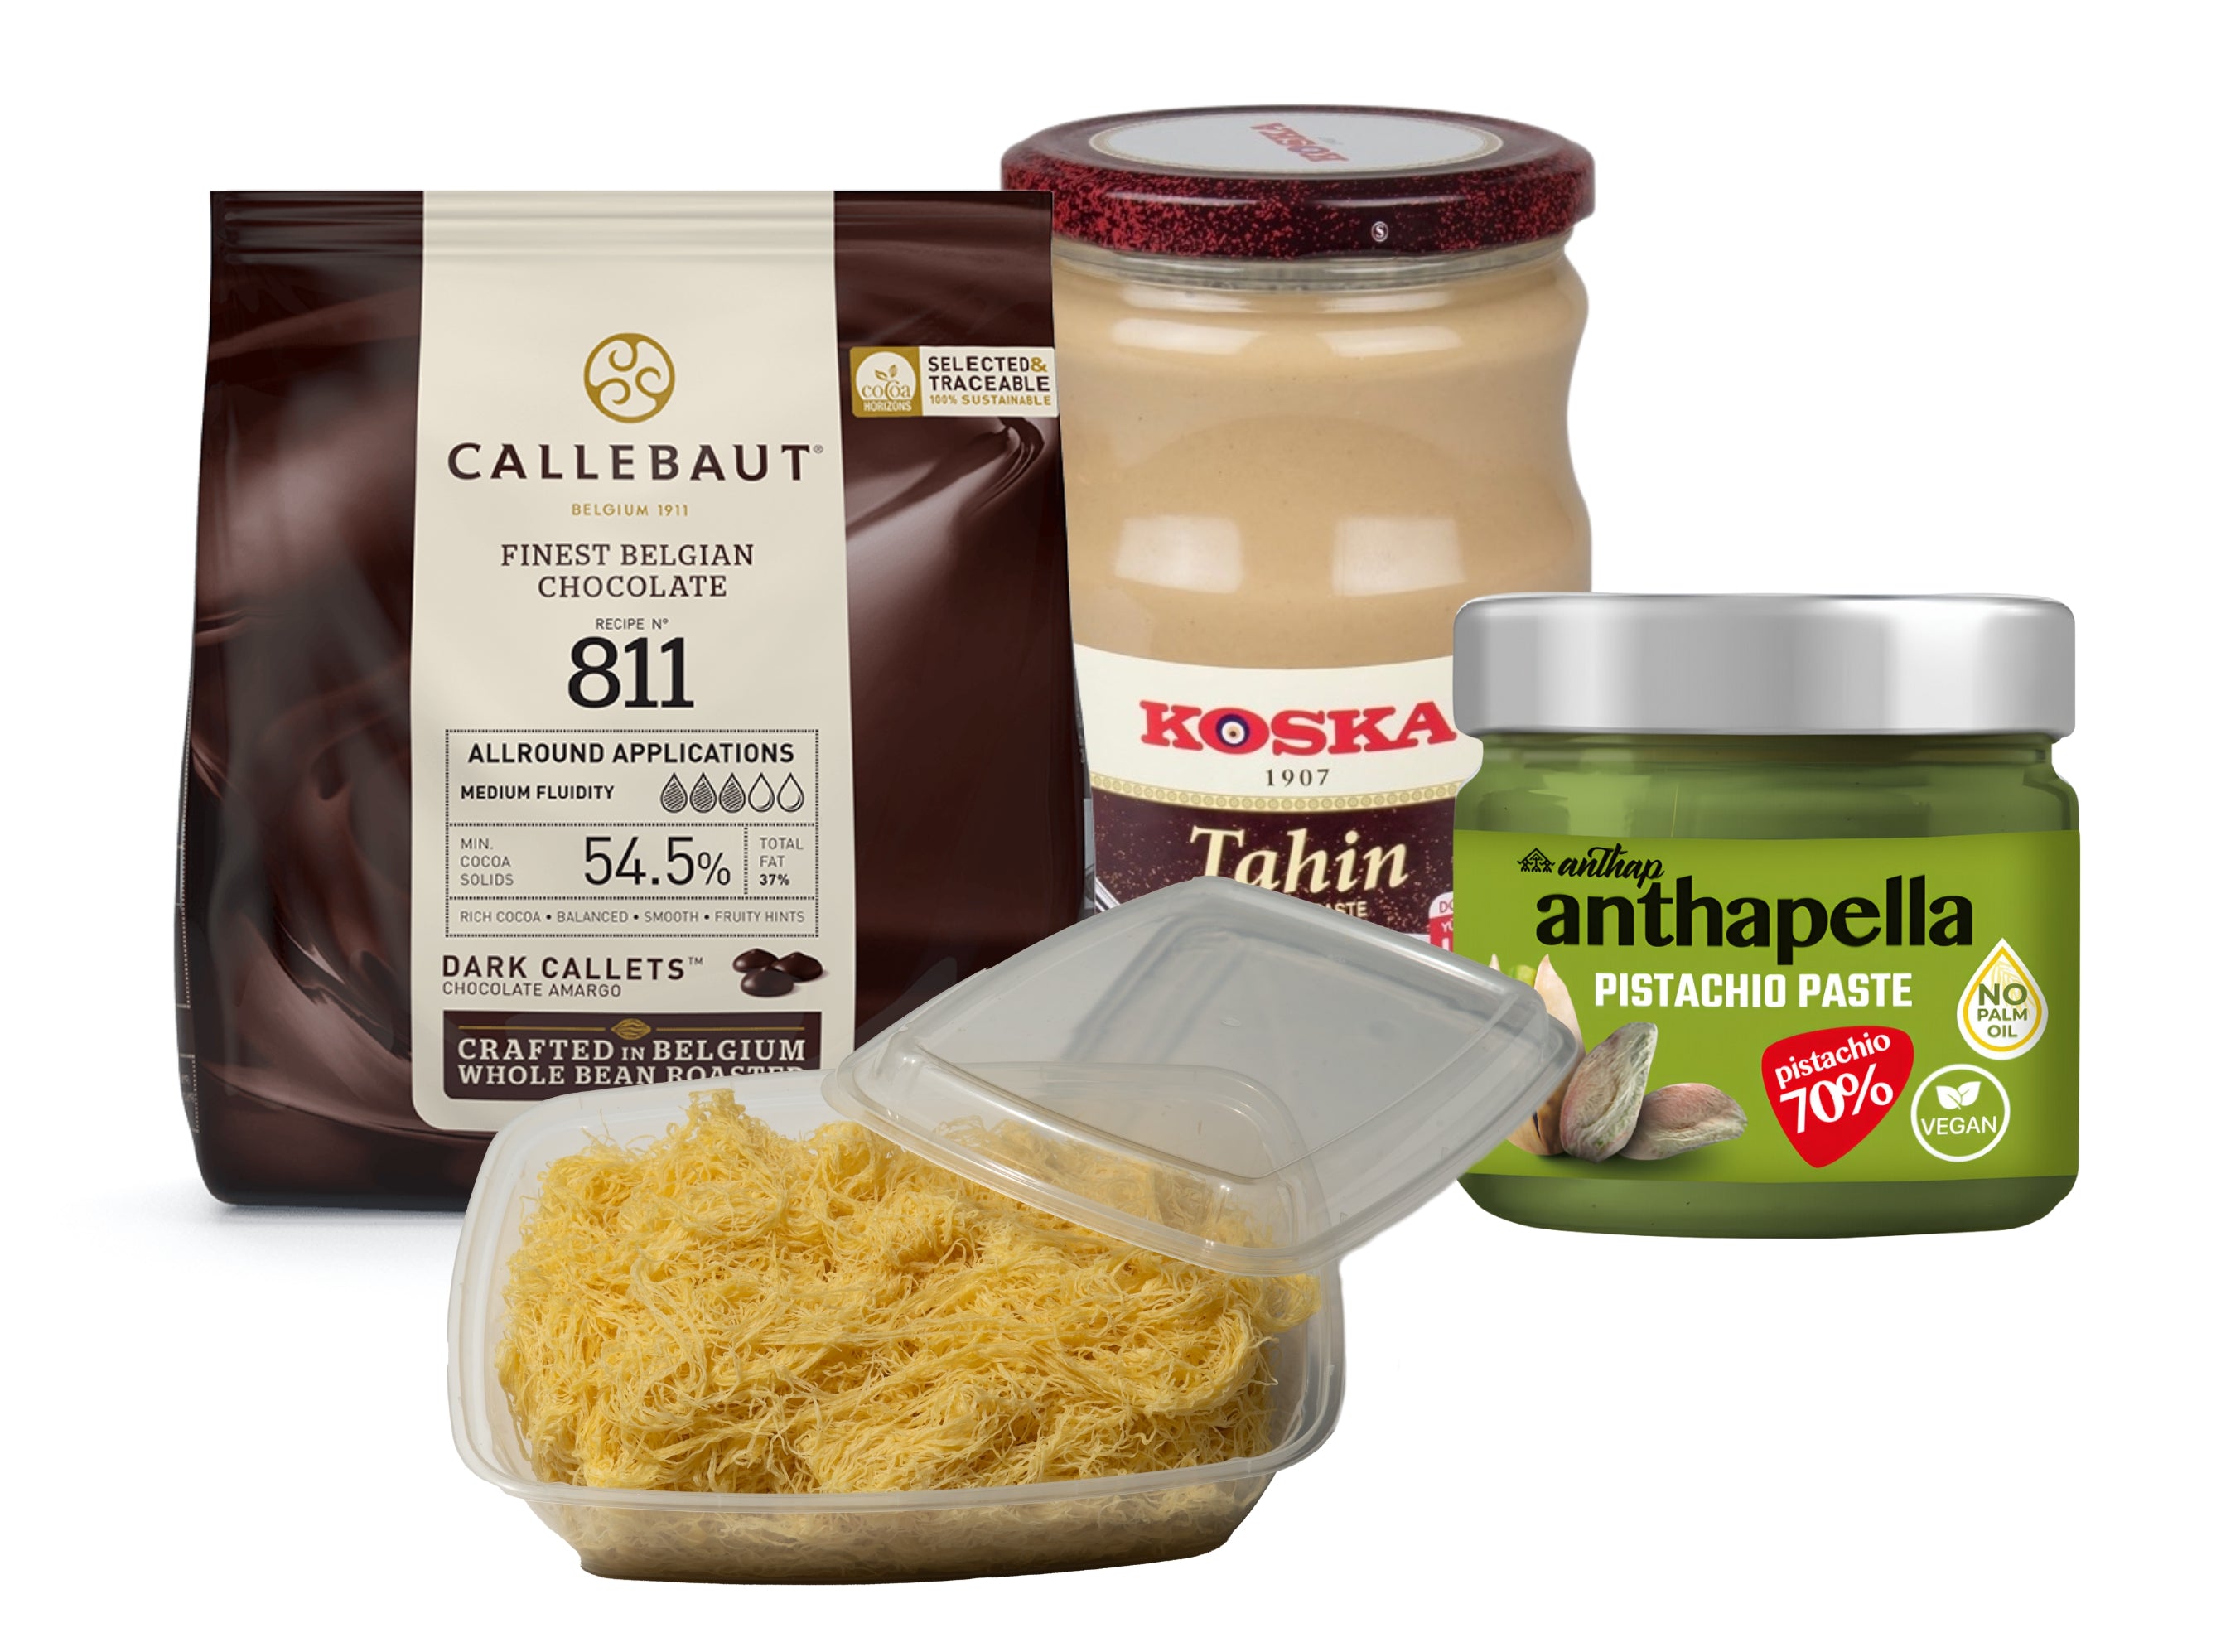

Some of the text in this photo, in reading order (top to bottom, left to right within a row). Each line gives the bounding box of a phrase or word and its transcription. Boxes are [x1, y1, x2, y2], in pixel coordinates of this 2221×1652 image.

[929, 375, 1050, 392] TRACEABLE
[863, 400, 912, 412] HORIZONS
[929, 394, 1051, 405] 100% SUSTAINABLE
[572, 503, 688, 517] BELGIUM 1911
[501, 544, 754, 567] FINEST BELGIAN
[538, 575, 727, 598] CHOCOLATE
[596, 618, 645, 630] RECIPE
[568, 636, 694, 708] 811
[1140, 700, 1457, 756] KOSKA
[468, 743, 794, 763] ALLROUND APPLICATIONS
[1267, 769, 1330, 786] 1907
[461, 785, 615, 799] MEDIUM FLUIDITY
[461, 838, 493, 849] MIN.
[760, 838, 804, 850] TOTAL
[461, 856, 511, 868] COCOA
[585, 837, 731, 886] 54.5%
[760, 856, 785, 867] FAT
[1190, 825, 1409, 895] Tahin
[1557, 843, 1665, 889] anthap
[461, 873, 514, 886] SOLIDS
[760, 874, 789, 886] 37%
[460, 911, 805, 923] RICH COCOA BALANCED SMOOTH FRUITY HINTS
[1325, 901, 1368, 917] STE
[1536, 875, 1973, 965] anthapella
[442, 955, 527, 978] DARK
[442, 982, 621, 997] CHOCOLATE AMARGO
[1595, 973, 1913, 1007] PISTACHIO PASTE
[1979, 983, 2028, 1006] NO
[1977, 1008, 2028, 1022] PALM
[1987, 1025, 2018, 1038] OIL
[458, 1039, 806, 1061] CRAFTED IN BELGIUM
[1774, 1031, 1890, 1089] pistachio
[458, 1065, 804, 1085] WHOLE BEAN ROAS
[1779, 1063, 1894, 1133] 70%
[1920, 1115, 1997, 1136] VEGAN
